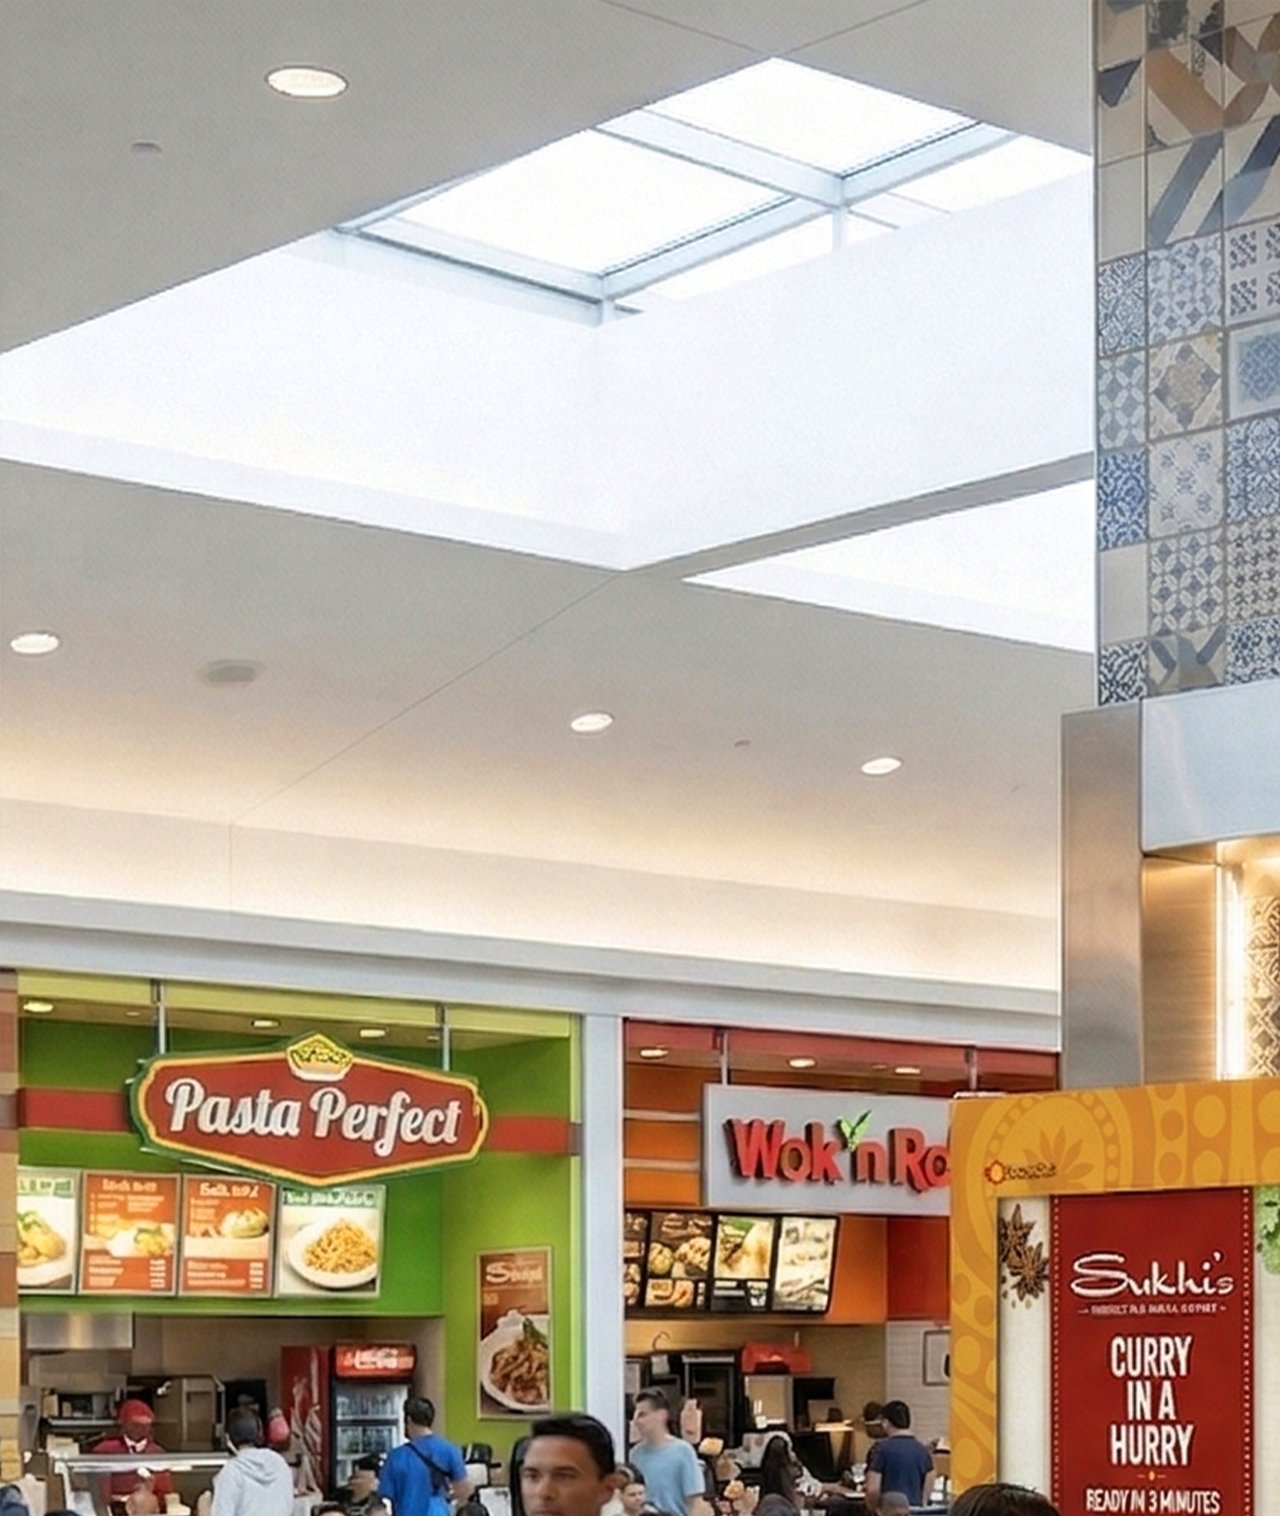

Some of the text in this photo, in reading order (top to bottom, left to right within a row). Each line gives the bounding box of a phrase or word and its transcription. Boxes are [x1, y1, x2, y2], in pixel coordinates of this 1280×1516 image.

[165, 1077, 463, 1157] Pasta Perfect
[722, 1117, 844, 1185] Wok
[1070, 1250, 1235, 1298] Sukhi's
[1111, 1335, 1193, 1378] CURRY
[1127, 1380, 1177, 1421] IN A
[1110, 1423, 1195, 1466] HURRY
[1086, 1488, 1130, 1513] READY
[1148, 1489, 1158, 1514] 3
[1160, 1489, 1221, 1515] MINUTES
